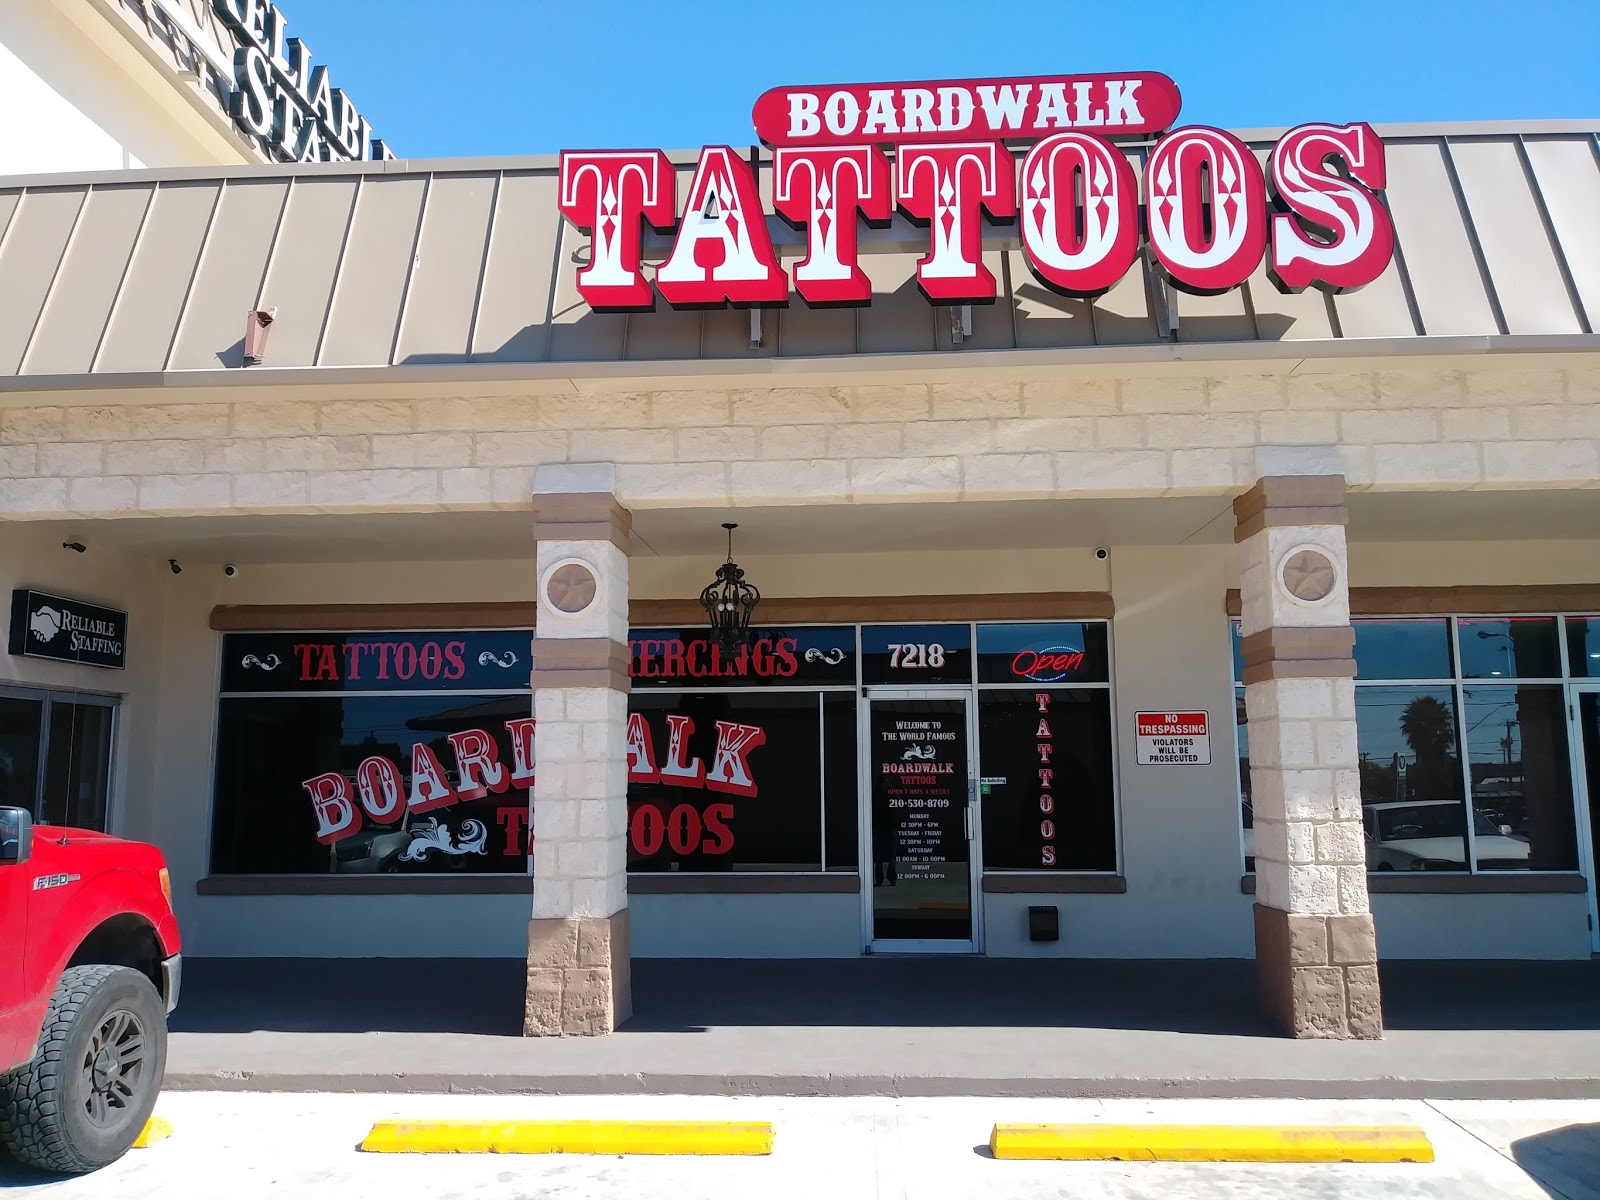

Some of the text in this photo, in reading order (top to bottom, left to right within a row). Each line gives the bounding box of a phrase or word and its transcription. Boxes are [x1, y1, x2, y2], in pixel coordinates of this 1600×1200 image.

[212, 0, 398, 160] ELIAB
[787, 80, 1145, 137] BOARDWALK
[561, 122, 1392, 309] TATTOOS
[61, 609, 115, 637] RELIABLE
[70, 630, 122, 656] STAFFING
[887, 643, 946, 669] 7218
[293, 637, 798, 681] TATTOOS IERCINGS
[1012, 649, 1084, 677] Open
[895, 721, 942, 730] WELCOME TO
[1139, 724, 1206, 734] TRESPASSING
[1165, 714, 1178, 723] NO
[881, 732, 956, 741] THE WORLD FAMOUS
[1152, 738, 1194, 746] VIOLATORS
[882, 763, 955, 774] BOARDWALK
[1149, 754, 1198, 762] PROSECUTED
[301, 712, 767, 846] BOARDALK
[900, 775, 937, 785] TATTOOS
[1035, 693, 1057, 866] TATTOOS
[497, 803, 735, 855] TOOS
